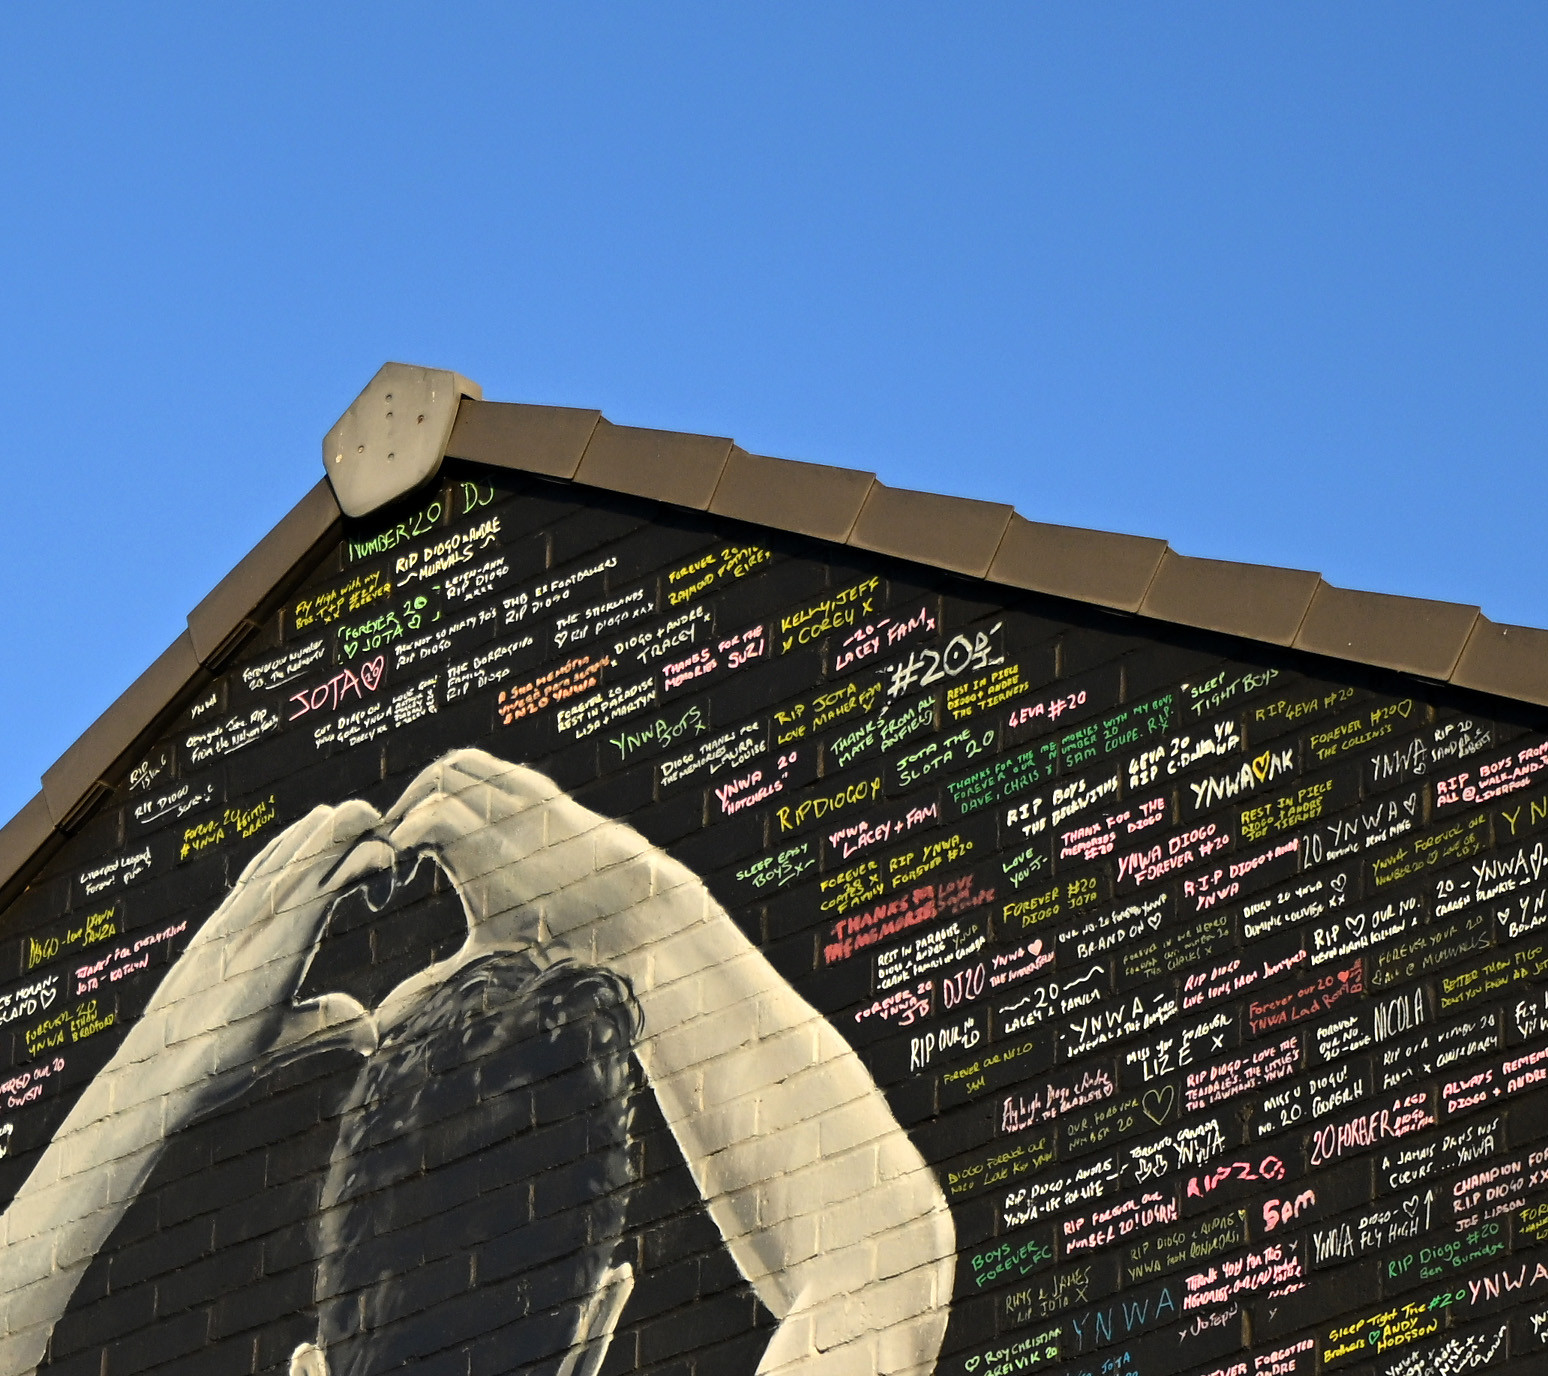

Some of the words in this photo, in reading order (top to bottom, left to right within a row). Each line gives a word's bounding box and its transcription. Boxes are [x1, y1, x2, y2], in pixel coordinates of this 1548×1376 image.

[289, 669, 361, 721] JOTA
[1374, 988, 1423, 1042] NICOLA
[1443, 1071, 1492, 1099] ALWAYS
[1454, 1161, 1522, 1197] CHAMPION
[1073, 1288, 1174, 1350] YNWA
